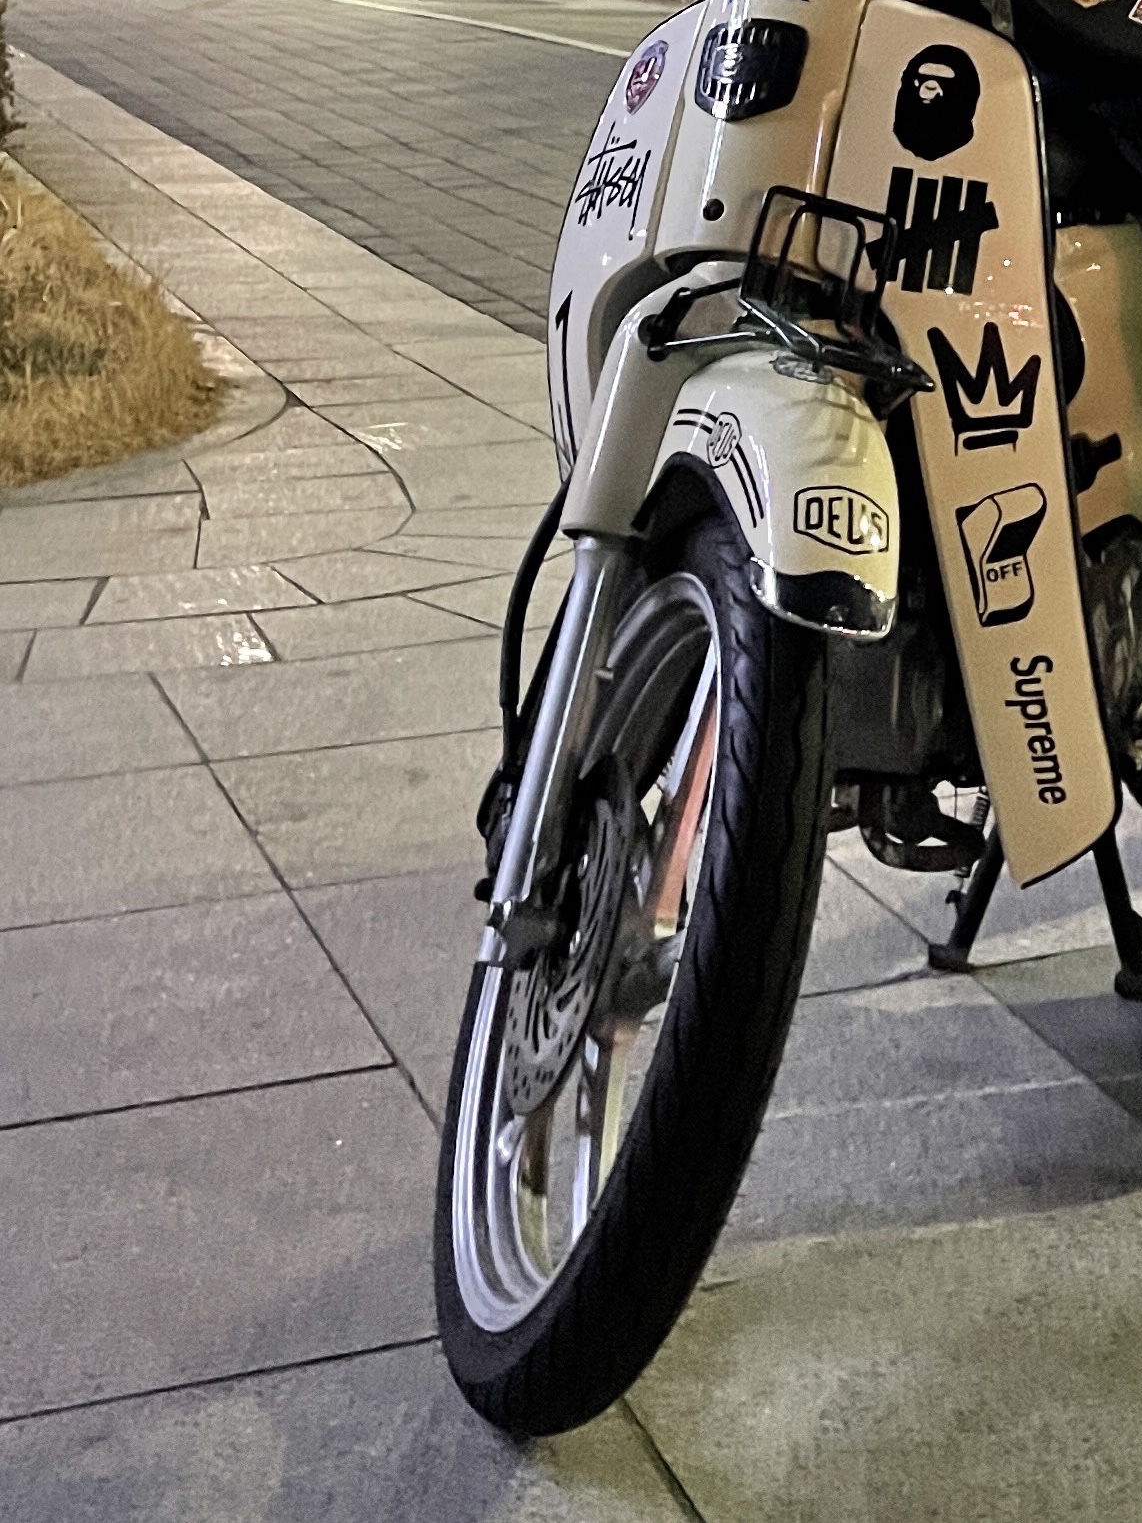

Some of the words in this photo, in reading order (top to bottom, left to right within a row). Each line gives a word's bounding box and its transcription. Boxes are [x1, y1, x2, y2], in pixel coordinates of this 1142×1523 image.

[805, 496, 884, 546] DEUS
[985, 560, 1024, 584] OFF
[1004, 654, 1067, 805] Supreme
